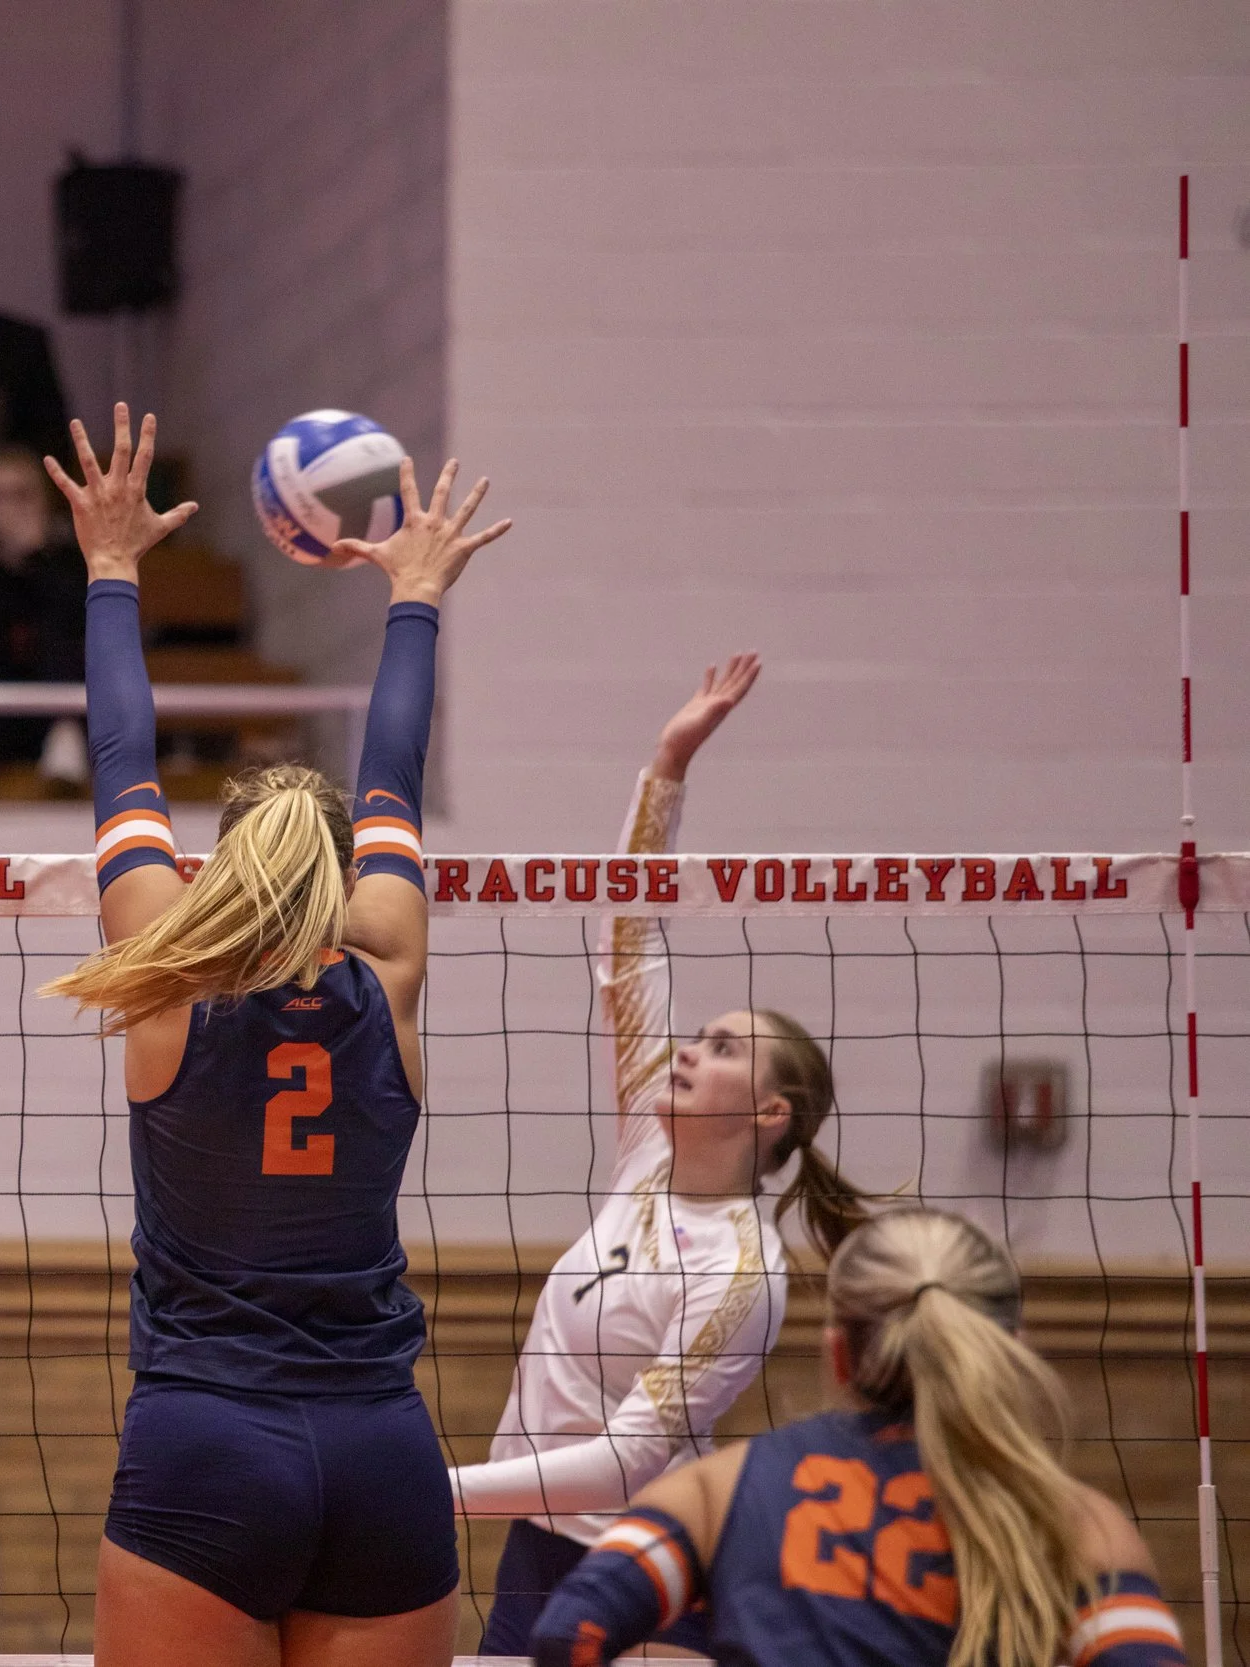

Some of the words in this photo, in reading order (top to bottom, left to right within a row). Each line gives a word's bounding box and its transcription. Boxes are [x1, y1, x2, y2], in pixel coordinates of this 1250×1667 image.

[424, 858, 678, 902] RACUSE
[706, 857, 1128, 902] VOLLEYBALL
[261, 1041, 335, 1175] 2
[780, 1454, 959, 1626] 22
